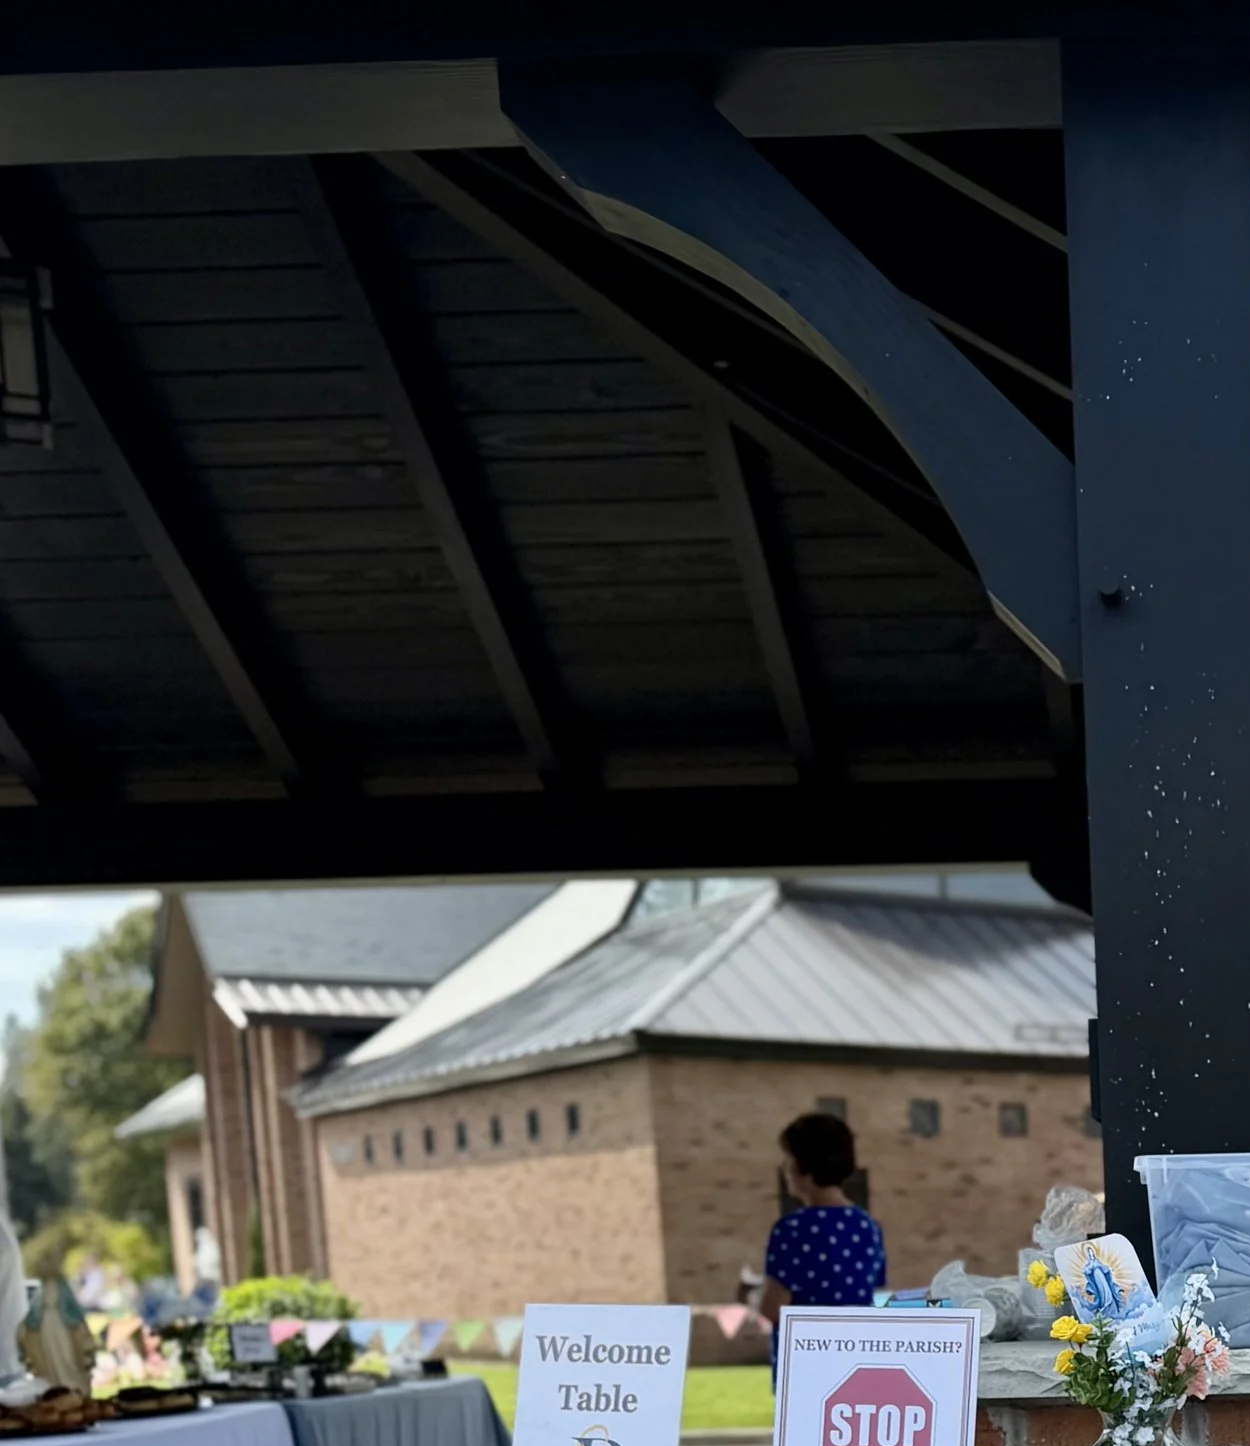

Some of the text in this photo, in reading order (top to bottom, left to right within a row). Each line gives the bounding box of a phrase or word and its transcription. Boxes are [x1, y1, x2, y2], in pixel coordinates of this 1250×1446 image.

[535, 1334, 671, 1365] Welcome
[794, 1338, 962, 1354] NEW TO THE PARISH?
[558, 1383, 639, 1413] Table
